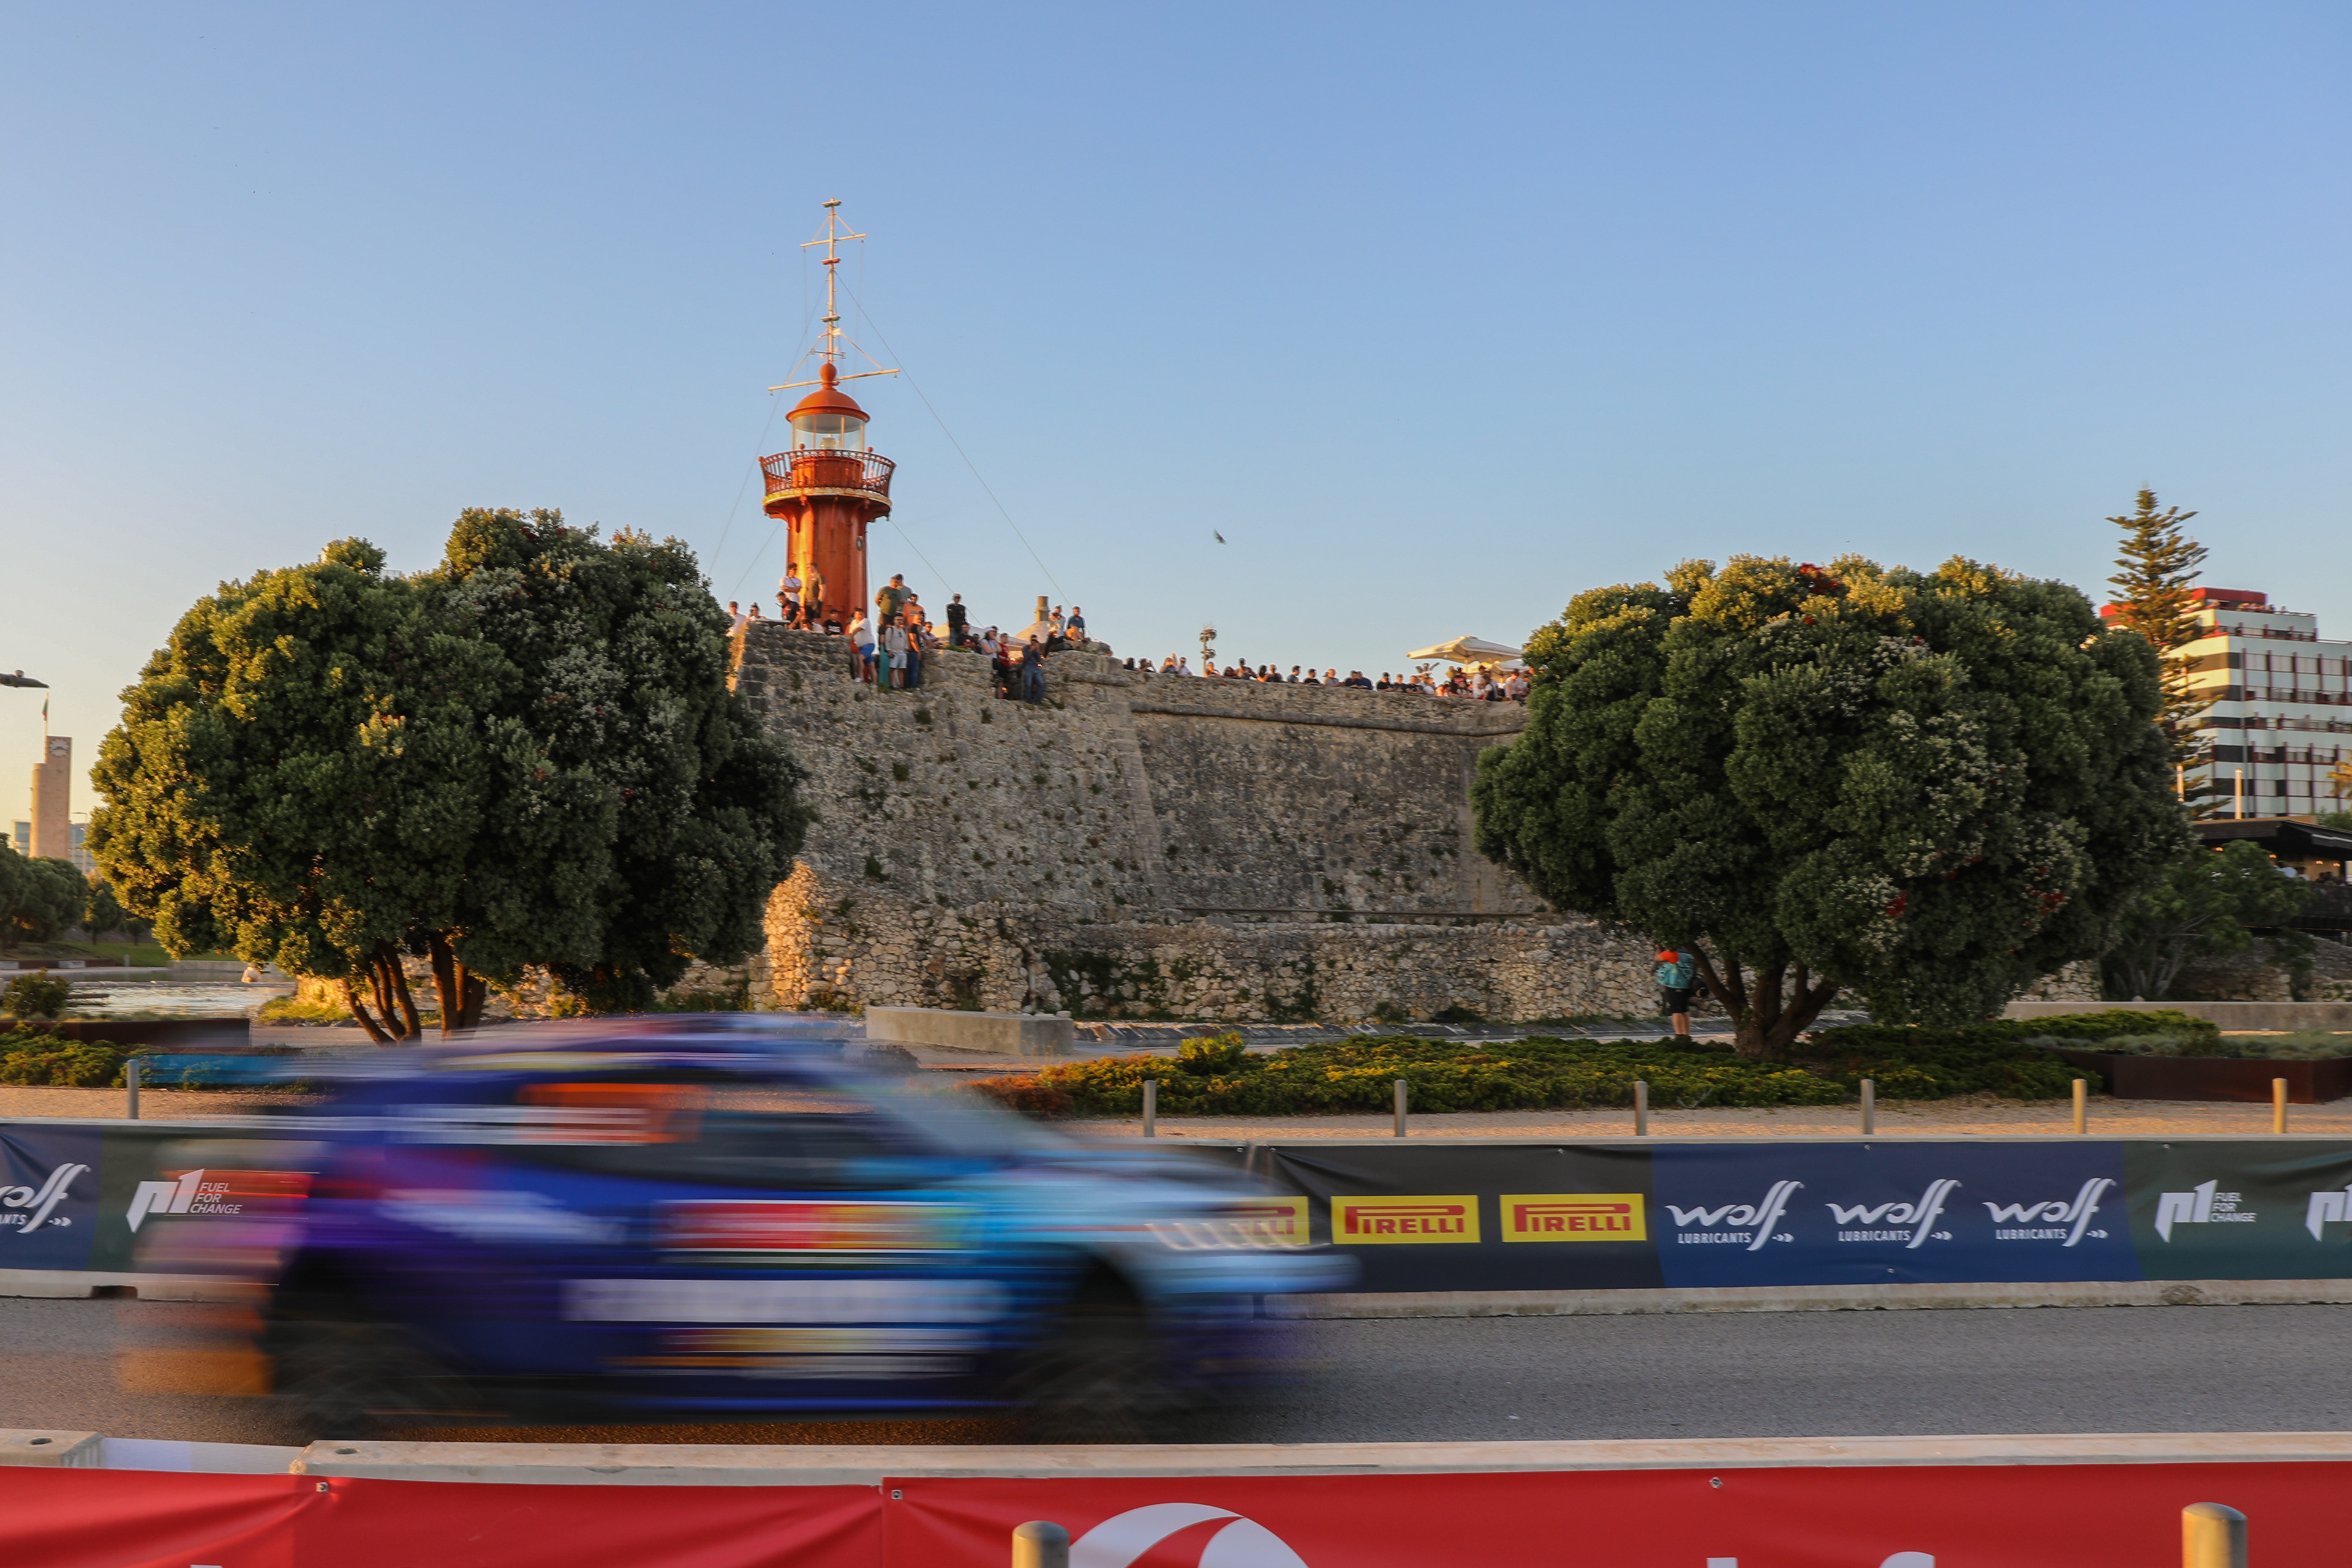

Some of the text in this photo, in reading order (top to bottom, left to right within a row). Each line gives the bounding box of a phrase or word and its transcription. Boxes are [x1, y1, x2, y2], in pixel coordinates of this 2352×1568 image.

[199, 1182, 230, 1193] FUEL
[195, 1193, 222, 1203] FOR
[2214, 1192, 2243, 1202] FUEL
[189, 1204, 243, 1215] CHANGE
[2212, 1202, 2237, 1212] FOR
[1344, 1205, 1466, 1234] PIRELLI
[1513, 1204, 1631, 1232] PIRELLI
[2210, 1212, 2257, 1223] CHANGE
[1678, 1232, 1752, 1245] LUBRICANTS
[1838, 1230, 1911, 1242] LUBRICANTS
[1996, 1228, 2067, 1240] LUBRICANTS
